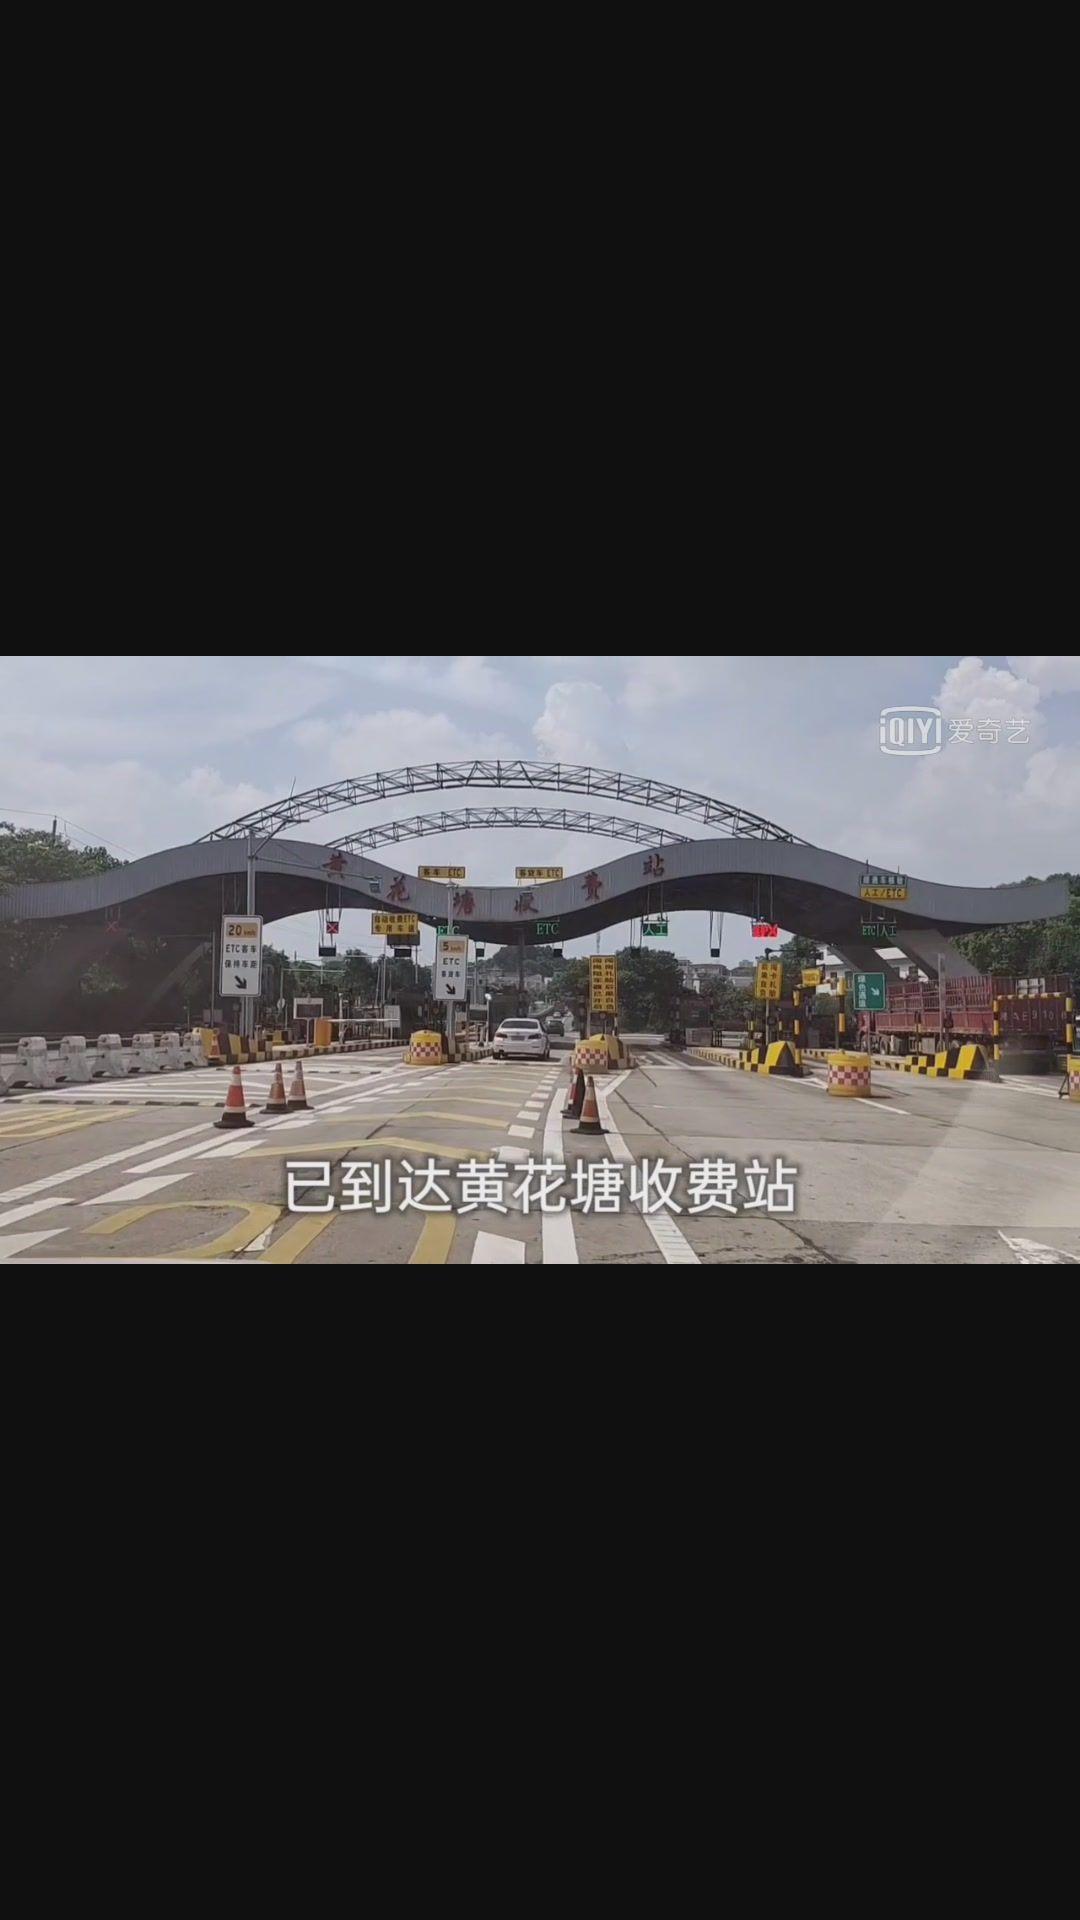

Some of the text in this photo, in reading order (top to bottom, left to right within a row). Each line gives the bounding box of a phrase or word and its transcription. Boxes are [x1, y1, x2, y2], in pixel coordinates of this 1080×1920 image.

[228, 925, 242, 936] 20
[536, 923, 559, 935] ETC
[644, 923, 667, 936] 人工
[442, 941, 449, 951] 5
[442, 957, 460, 966] ETC
